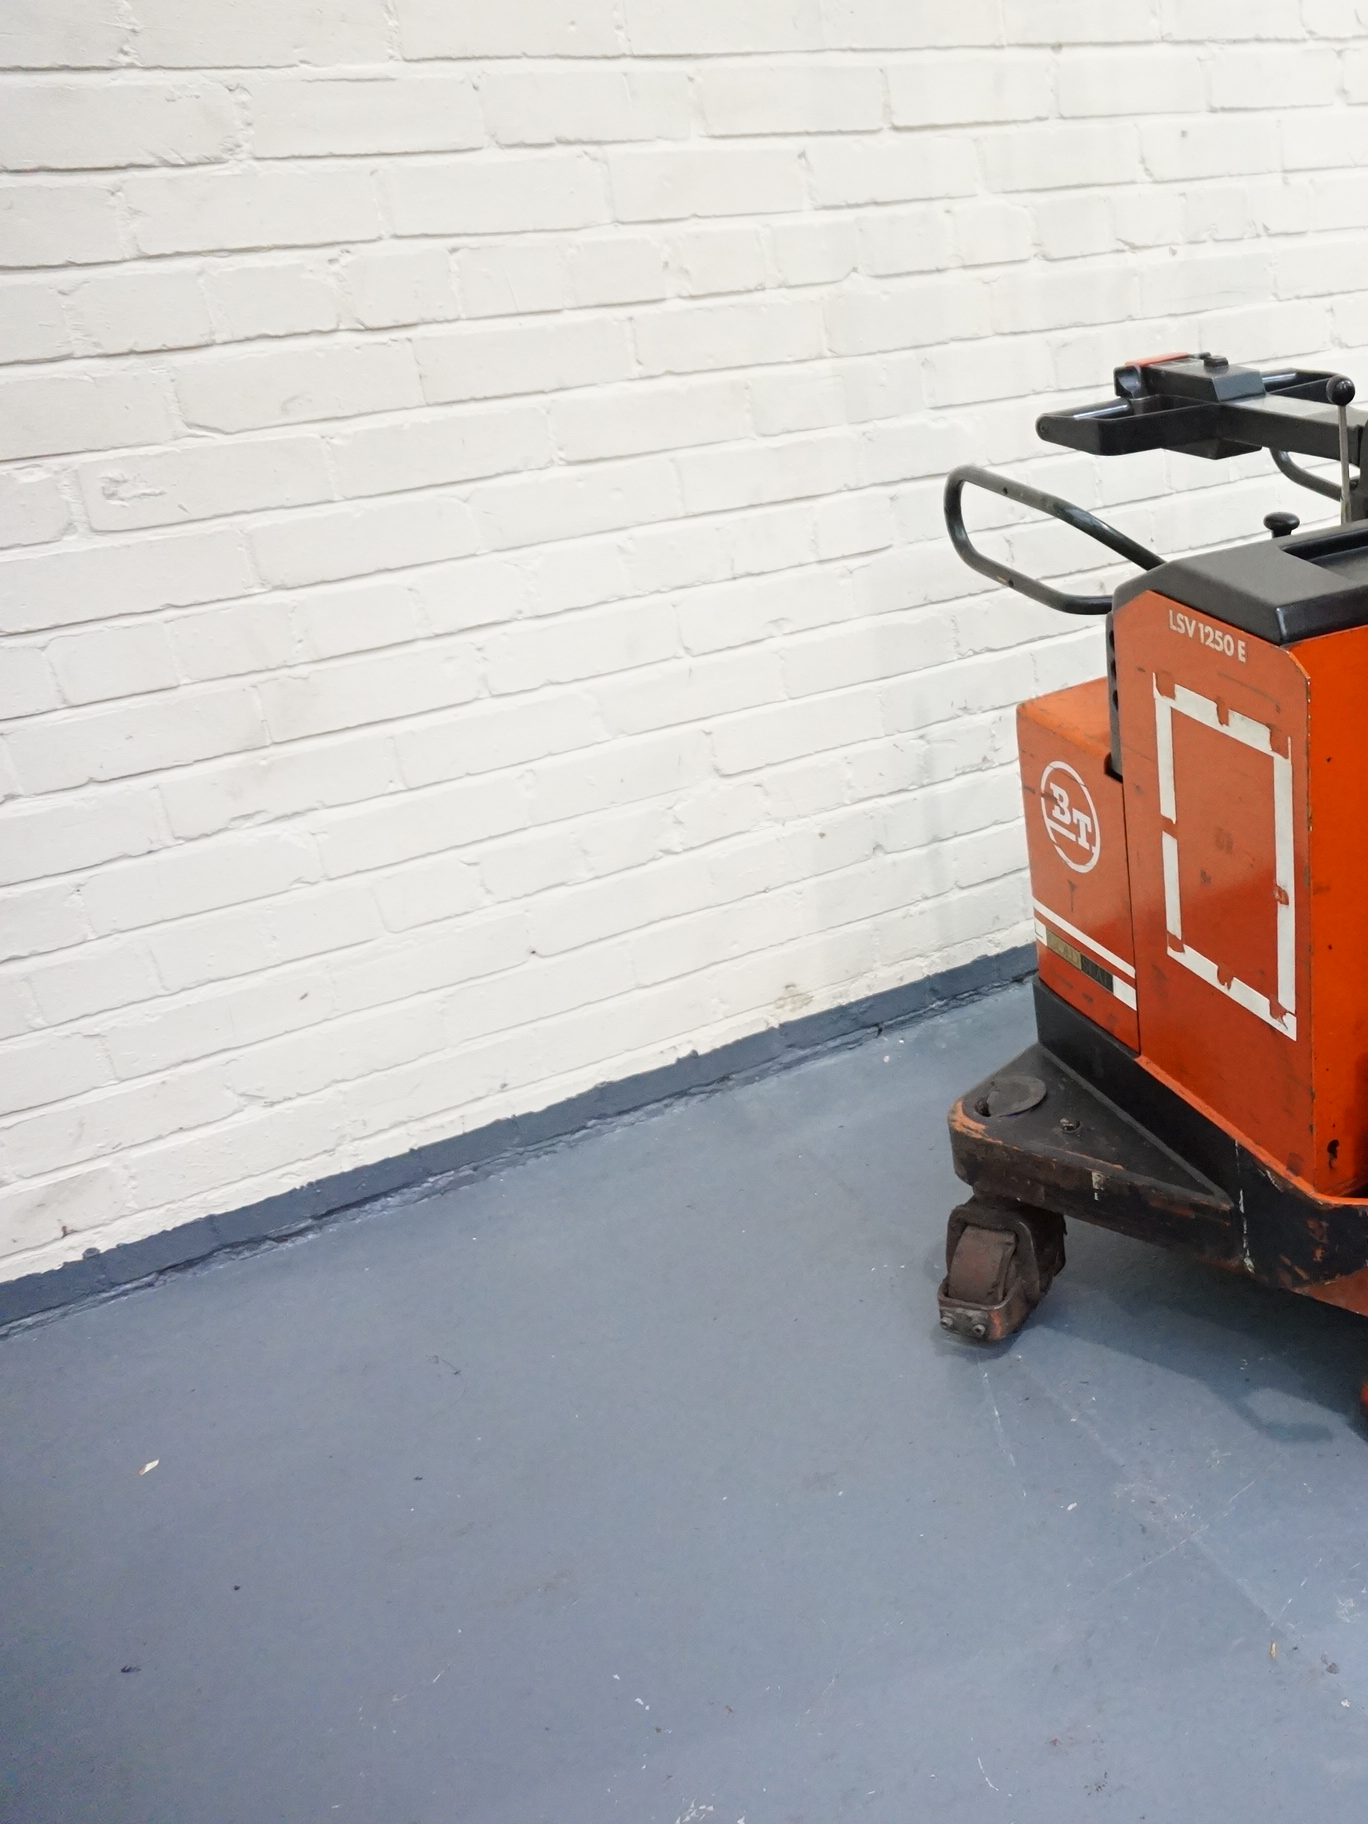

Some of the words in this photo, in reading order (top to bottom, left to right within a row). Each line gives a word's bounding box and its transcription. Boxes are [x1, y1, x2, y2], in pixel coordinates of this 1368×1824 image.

[1168, 609, 1197, 638] LSV
[1198, 622, 1235, 657] 1250
[1237, 639, 1247, 663] E
[1049, 781, 1092, 851] BT
